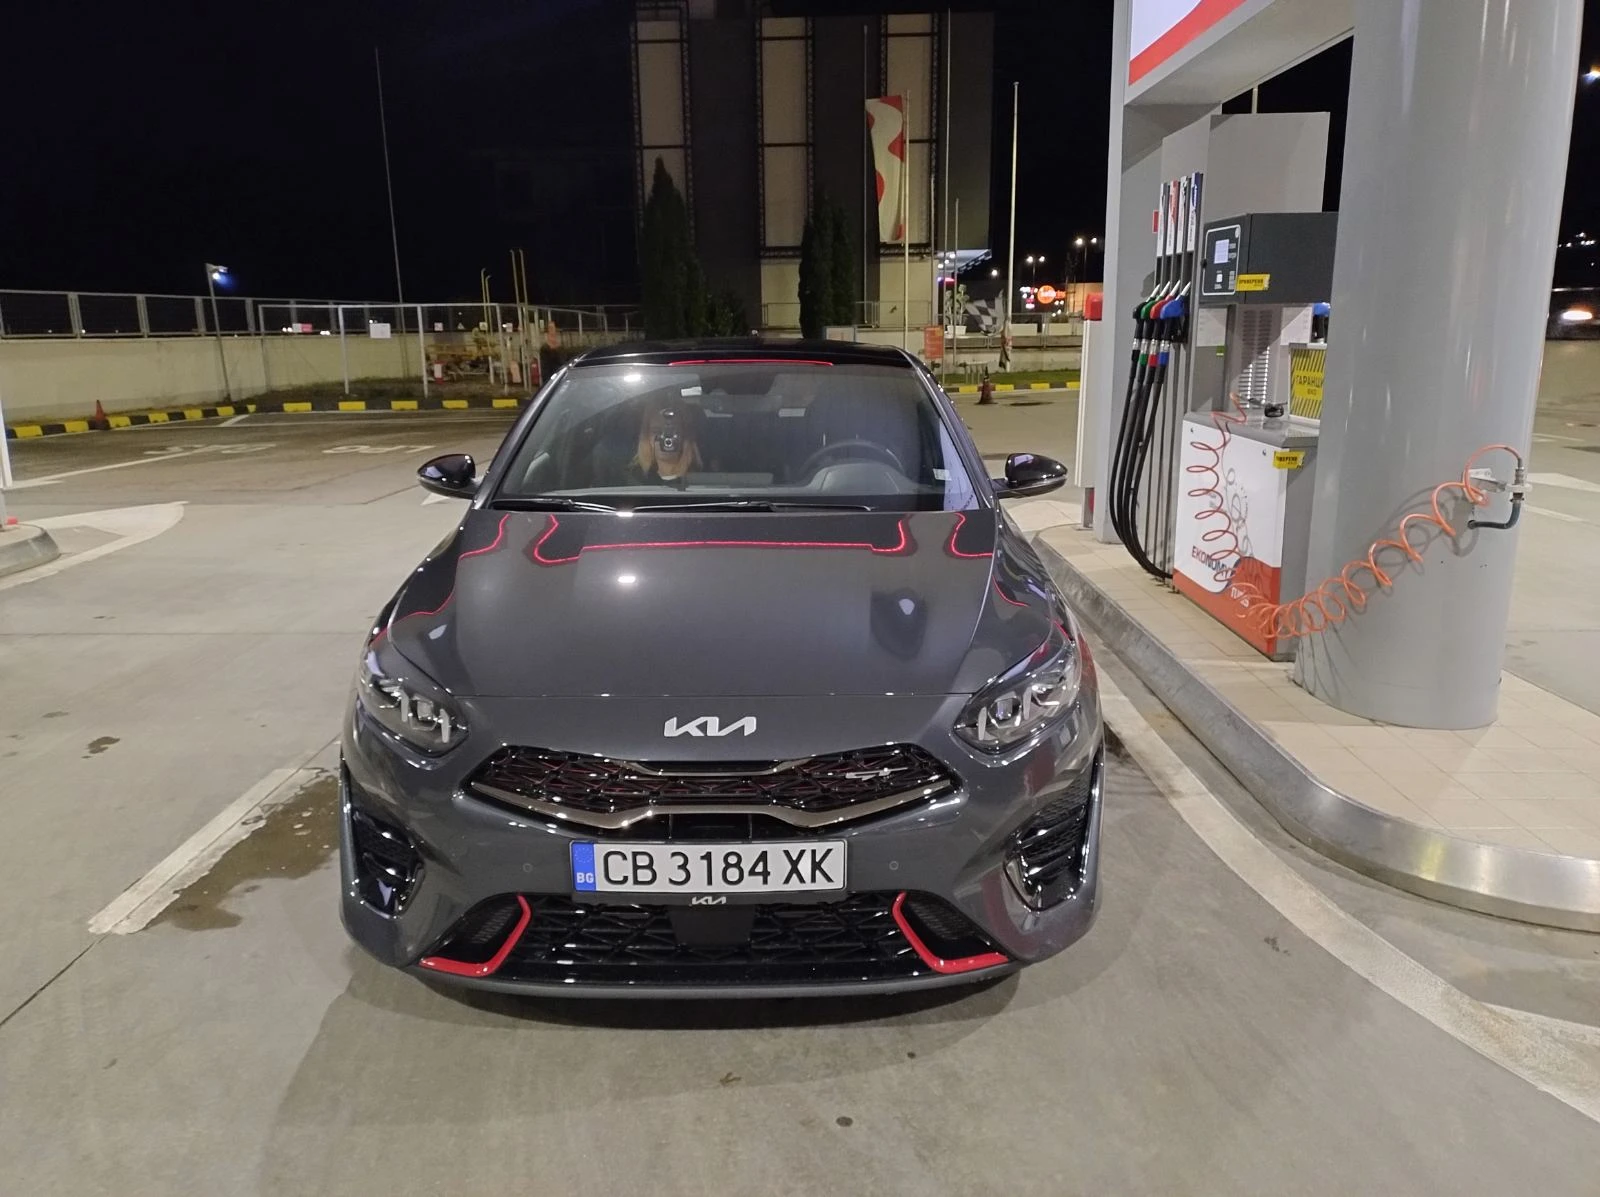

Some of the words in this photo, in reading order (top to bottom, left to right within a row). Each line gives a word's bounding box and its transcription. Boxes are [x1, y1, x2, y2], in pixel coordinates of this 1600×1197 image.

[322, 444, 436, 454] LPG
[664, 716, 757, 737] KIA
[576, 872, 594, 884] BG
[603, 850, 658, 886] CB
[668, 850, 771, 887] 3184
[782, 848, 835, 885] XK
[691, 896, 727, 905] KIA
